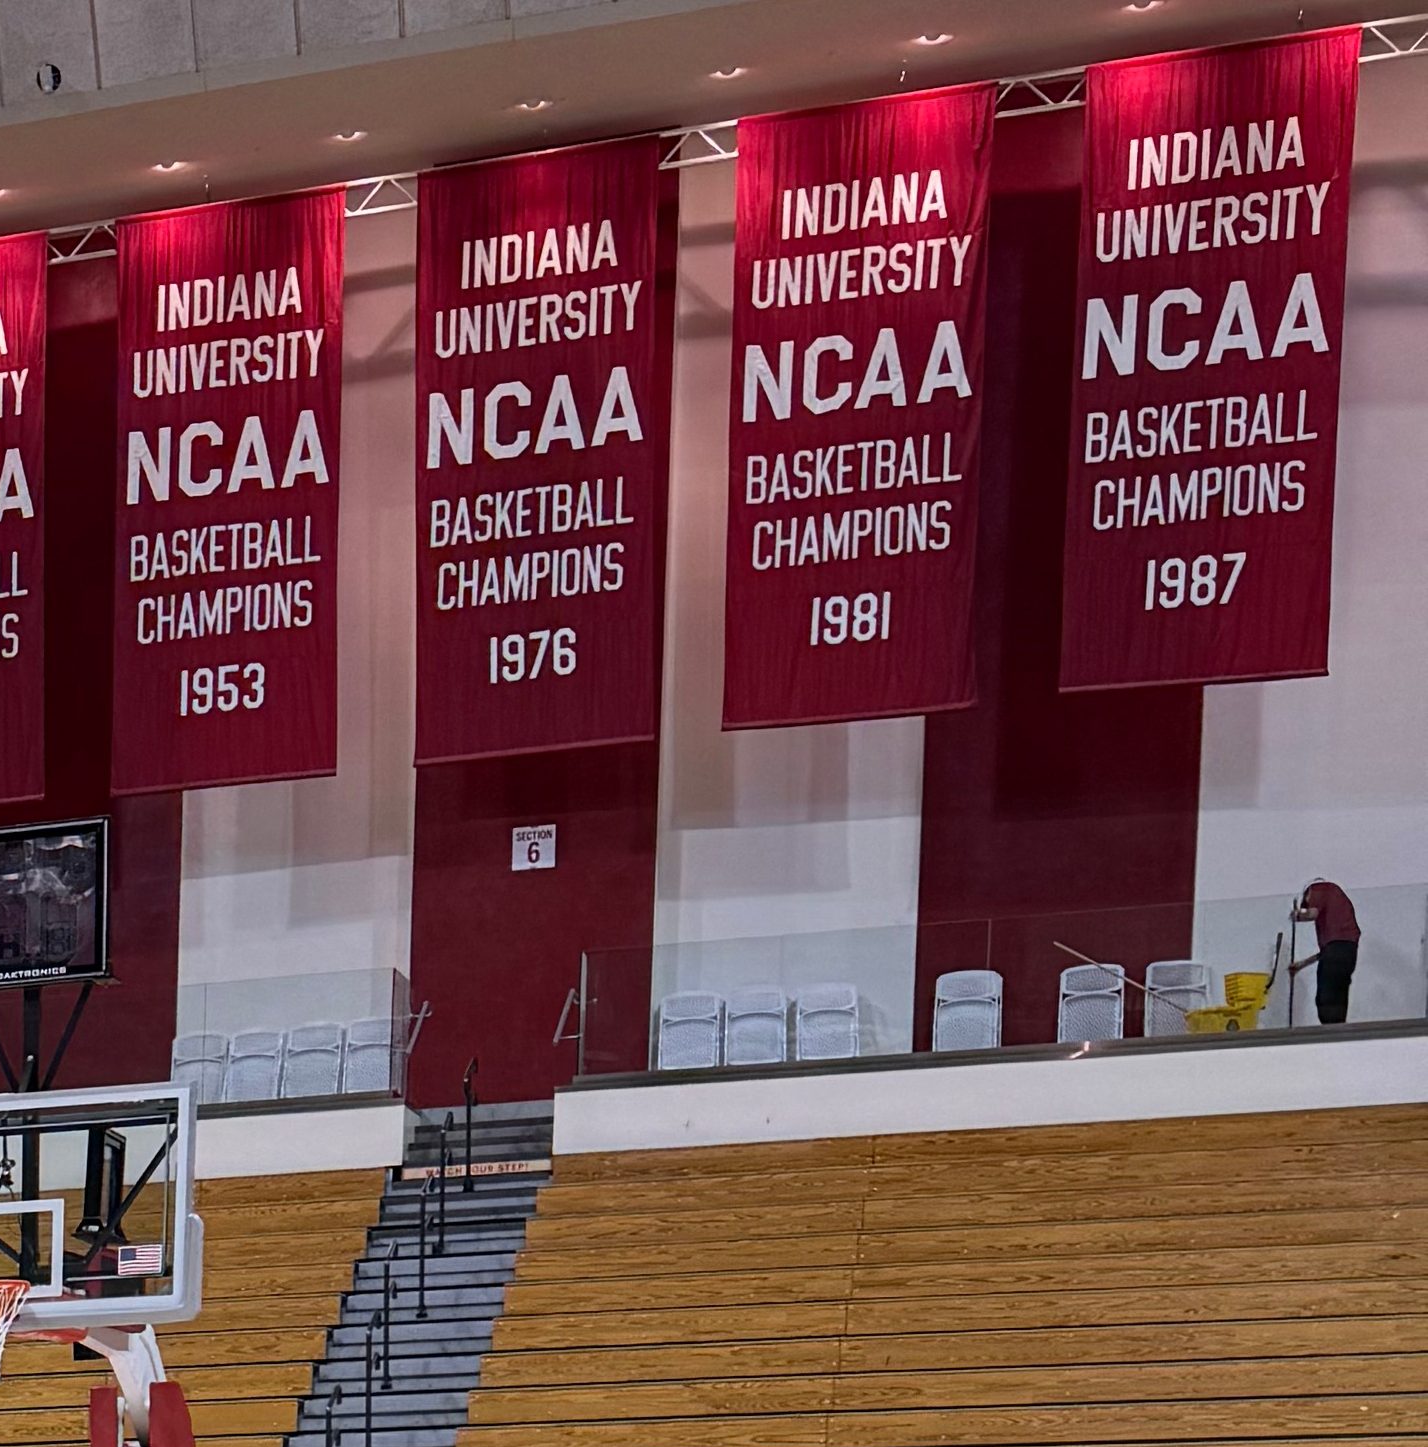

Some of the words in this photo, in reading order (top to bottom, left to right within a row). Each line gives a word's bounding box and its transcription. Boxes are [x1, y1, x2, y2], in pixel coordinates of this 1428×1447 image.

[1127, 116, 1304, 191] INDIANA
[781, 169, 947, 240] INDIANA
[1095, 182, 1330, 263] UNIVERSITY
[461, 220, 618, 289] INDIANA
[751, 234, 972, 309] UNIVERSITY
[157, 267, 301, 332] INDIANA
[435, 280, 642, 358] UNIVERSITY
[1081, 273, 1330, 380] NCAA
[133, 329, 325, 398] UNIVERSITY
[742, 321, 972, 423] NCAA
[427, 367, 643, 469] NCAA
[1085, 390, 1317, 463] BASKETBALL
[127, 410, 329, 505] NCAA
[746, 432, 962, 505] BASKETBALL
[430, 477, 634, 548] BASKETBALL
[1093, 461, 1305, 531] CHAMPIONS
[130, 516, 321, 582] BASKETBALL
[752, 500, 951, 570] CHAMPIONS
[437, 542, 624, 610] CHAMPIONS
[1145, 552, 1246, 611] 1987
[137, 580, 313, 644] CHAMPIONS
[810, 592, 890, 645] 1981
[180, 662, 265, 716] 1953
[490, 627, 576, 684] 1976
[516, 829, 553, 842] SECTION
[527, 841, 540, 864] 6
[425, 1166, 463, 1177] WACH
